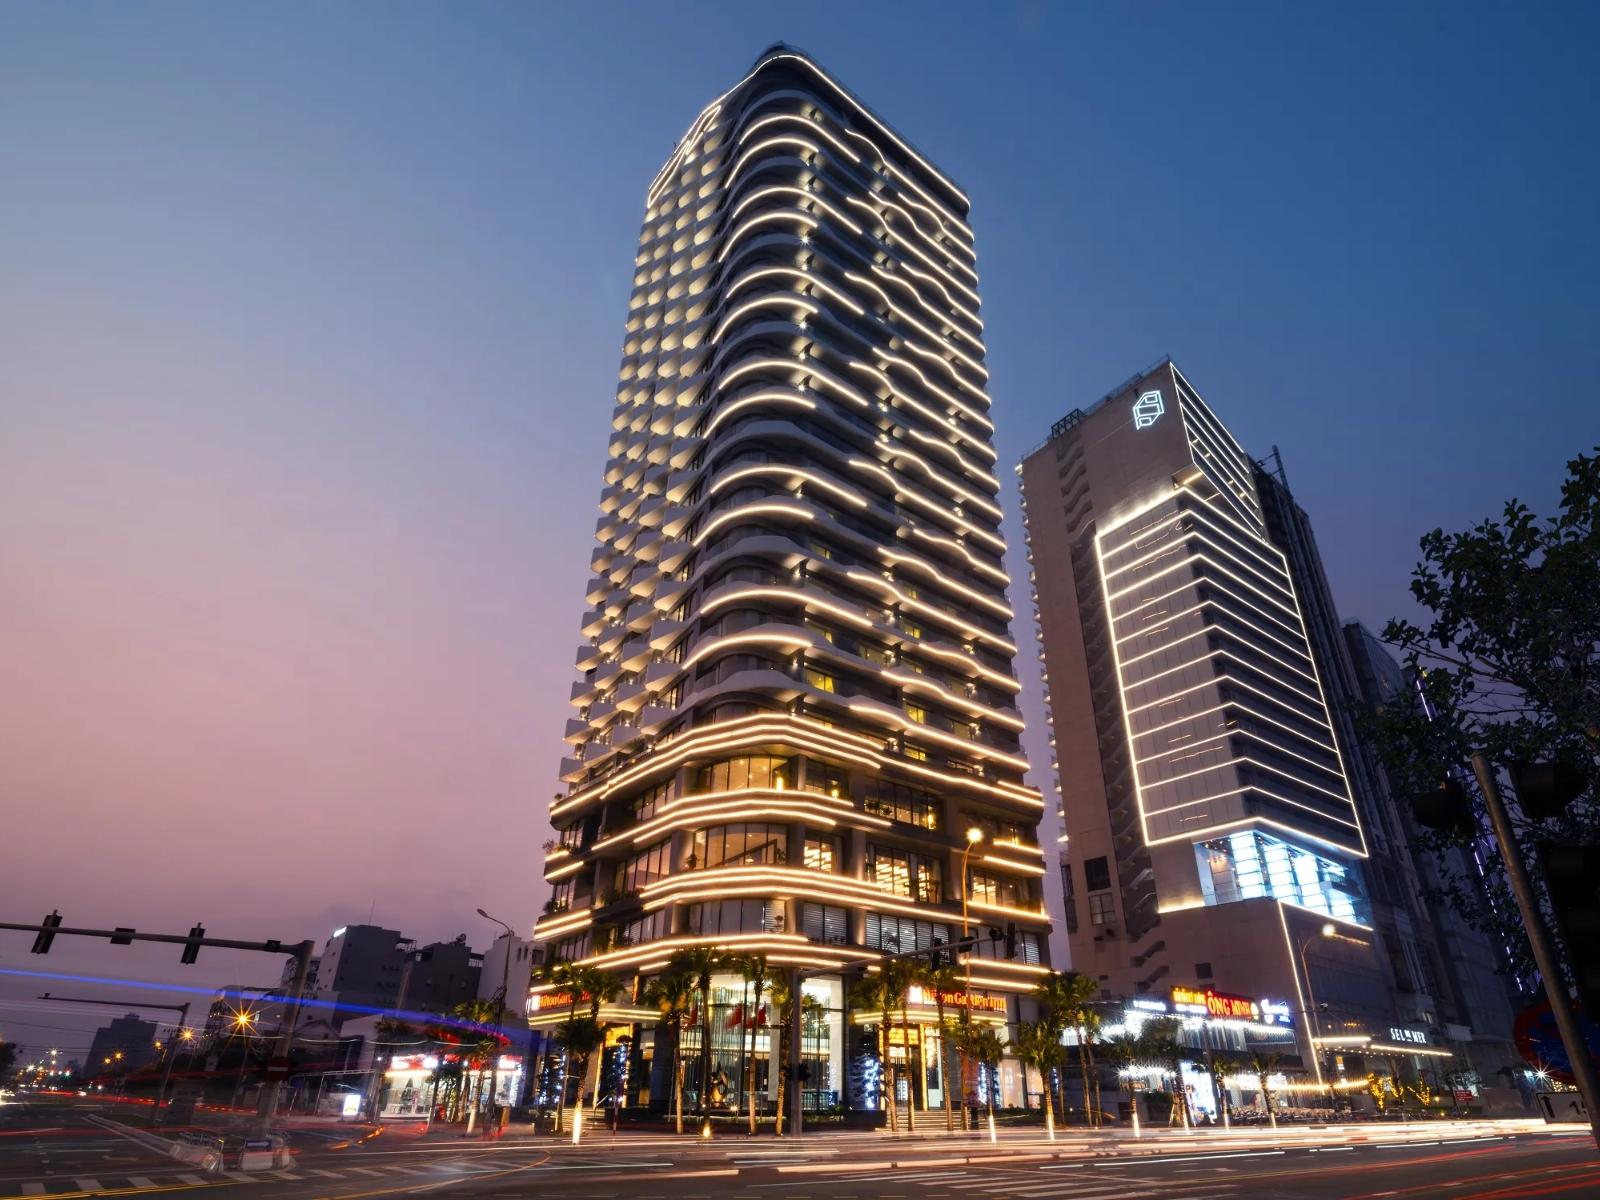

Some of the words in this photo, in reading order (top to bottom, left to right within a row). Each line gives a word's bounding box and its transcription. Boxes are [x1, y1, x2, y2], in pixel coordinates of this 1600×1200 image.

[923, 988, 954, 1004] Hilon
[1207, 990, 1231, 1015] ÔNG
[1231, 1000, 1252, 1016] MINH
[1390, 1027, 1405, 1041] SEL
